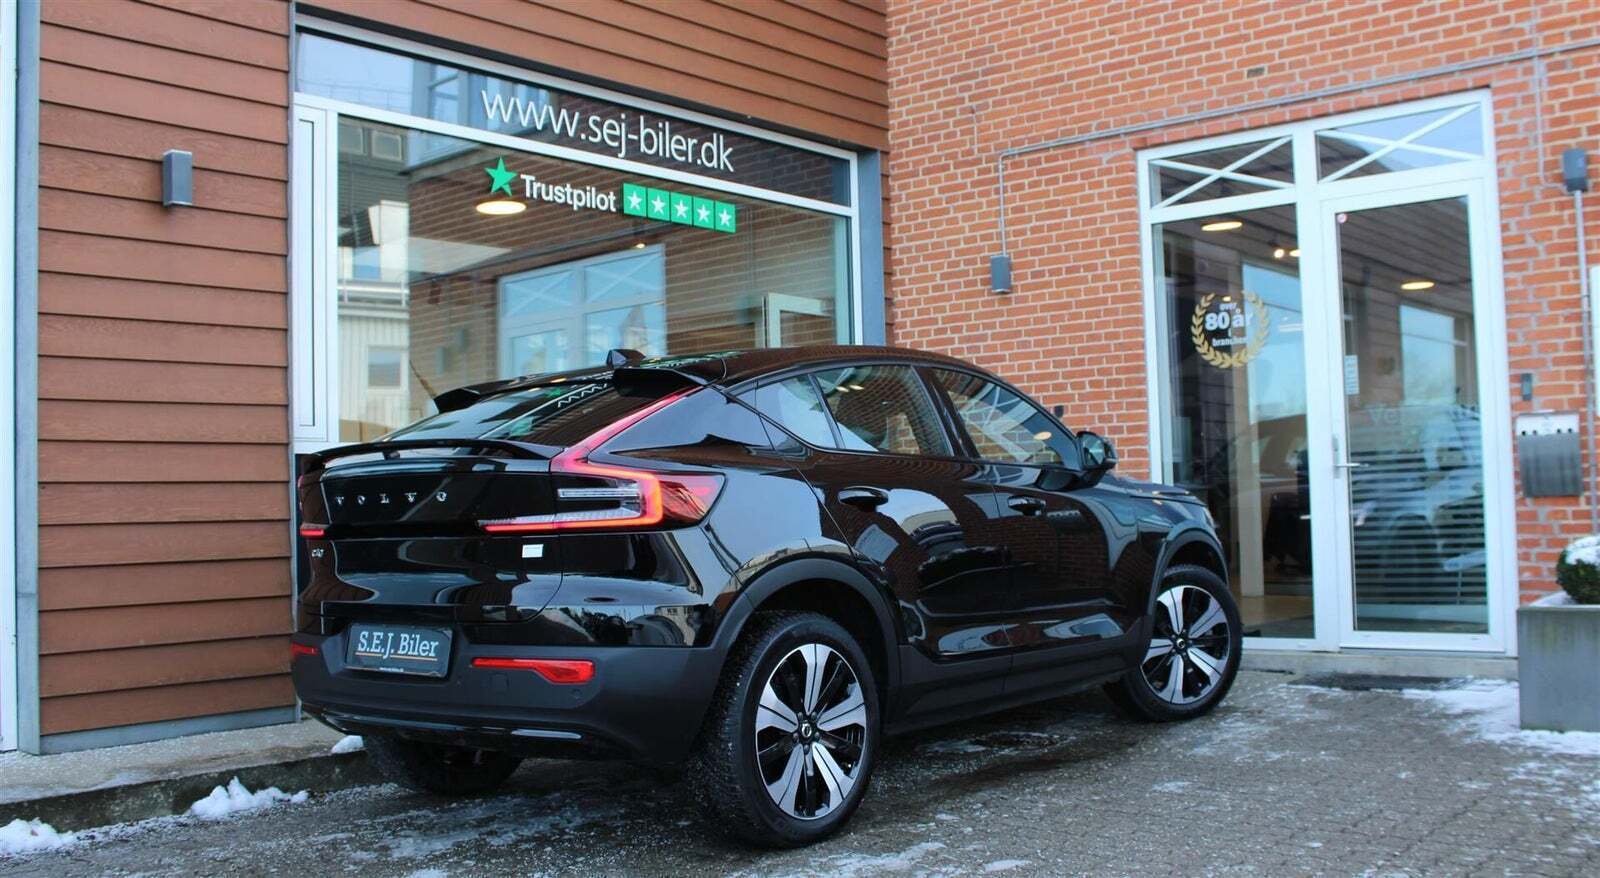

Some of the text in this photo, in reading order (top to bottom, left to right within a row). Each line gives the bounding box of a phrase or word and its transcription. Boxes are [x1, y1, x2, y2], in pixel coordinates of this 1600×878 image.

[481, 90, 734, 173] www.sej-biler.dk
[520, 173, 616, 212] Trustpilot
[1205, 311, 1230, 331] 80
[336, 491, 447, 506] VOLVO
[357, 630, 439, 659] S.E.J. Biler
